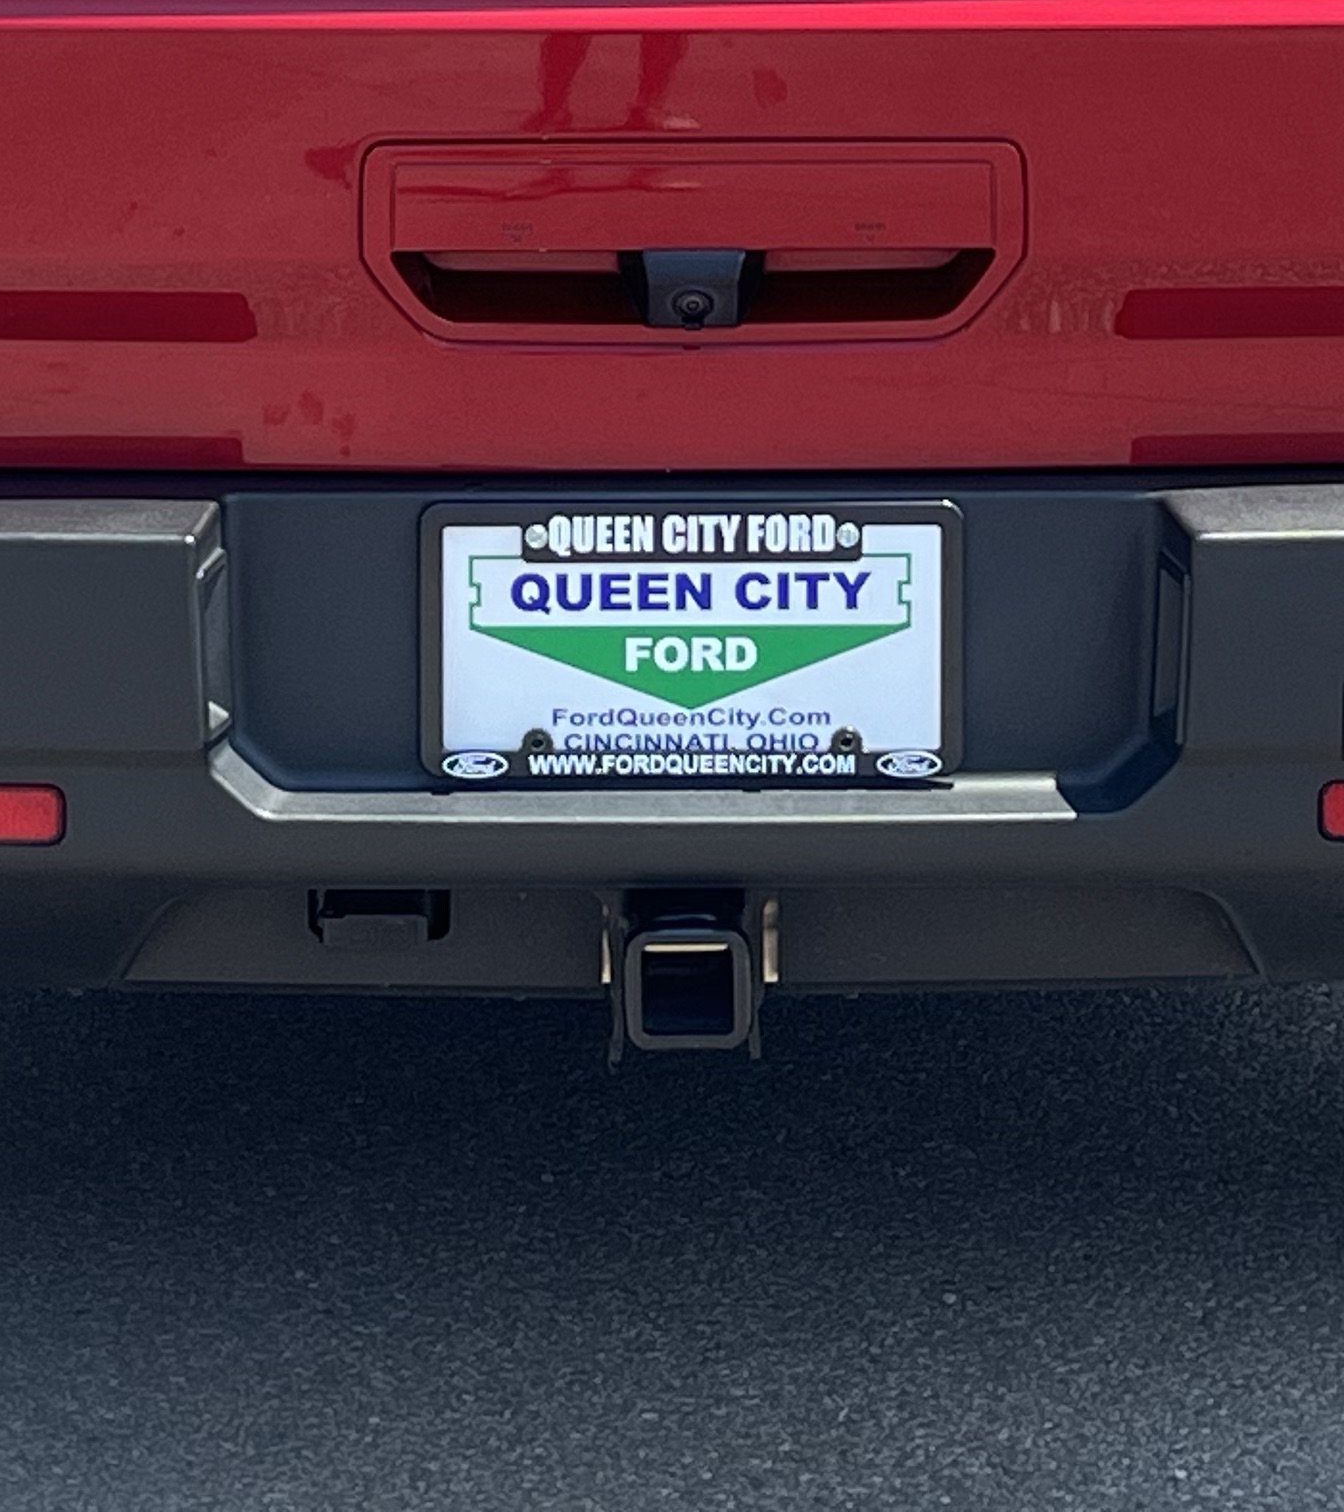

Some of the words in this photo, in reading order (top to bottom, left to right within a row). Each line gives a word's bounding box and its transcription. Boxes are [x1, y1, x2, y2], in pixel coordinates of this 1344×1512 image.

[548, 515, 654, 556] QUEEN
[662, 514, 741, 553] CITY
[747, 514, 836, 552] FORD
[511, 573, 713, 614] QUEEN
[735, 572, 871, 610] CITY
[625, 636, 758, 672] FORD
[552, 707, 831, 729] FordQueenCity.Com
[747, 733, 819, 752] OHIO
[528, 753, 855, 776] WWW.FORDQUEENCITY.COM
